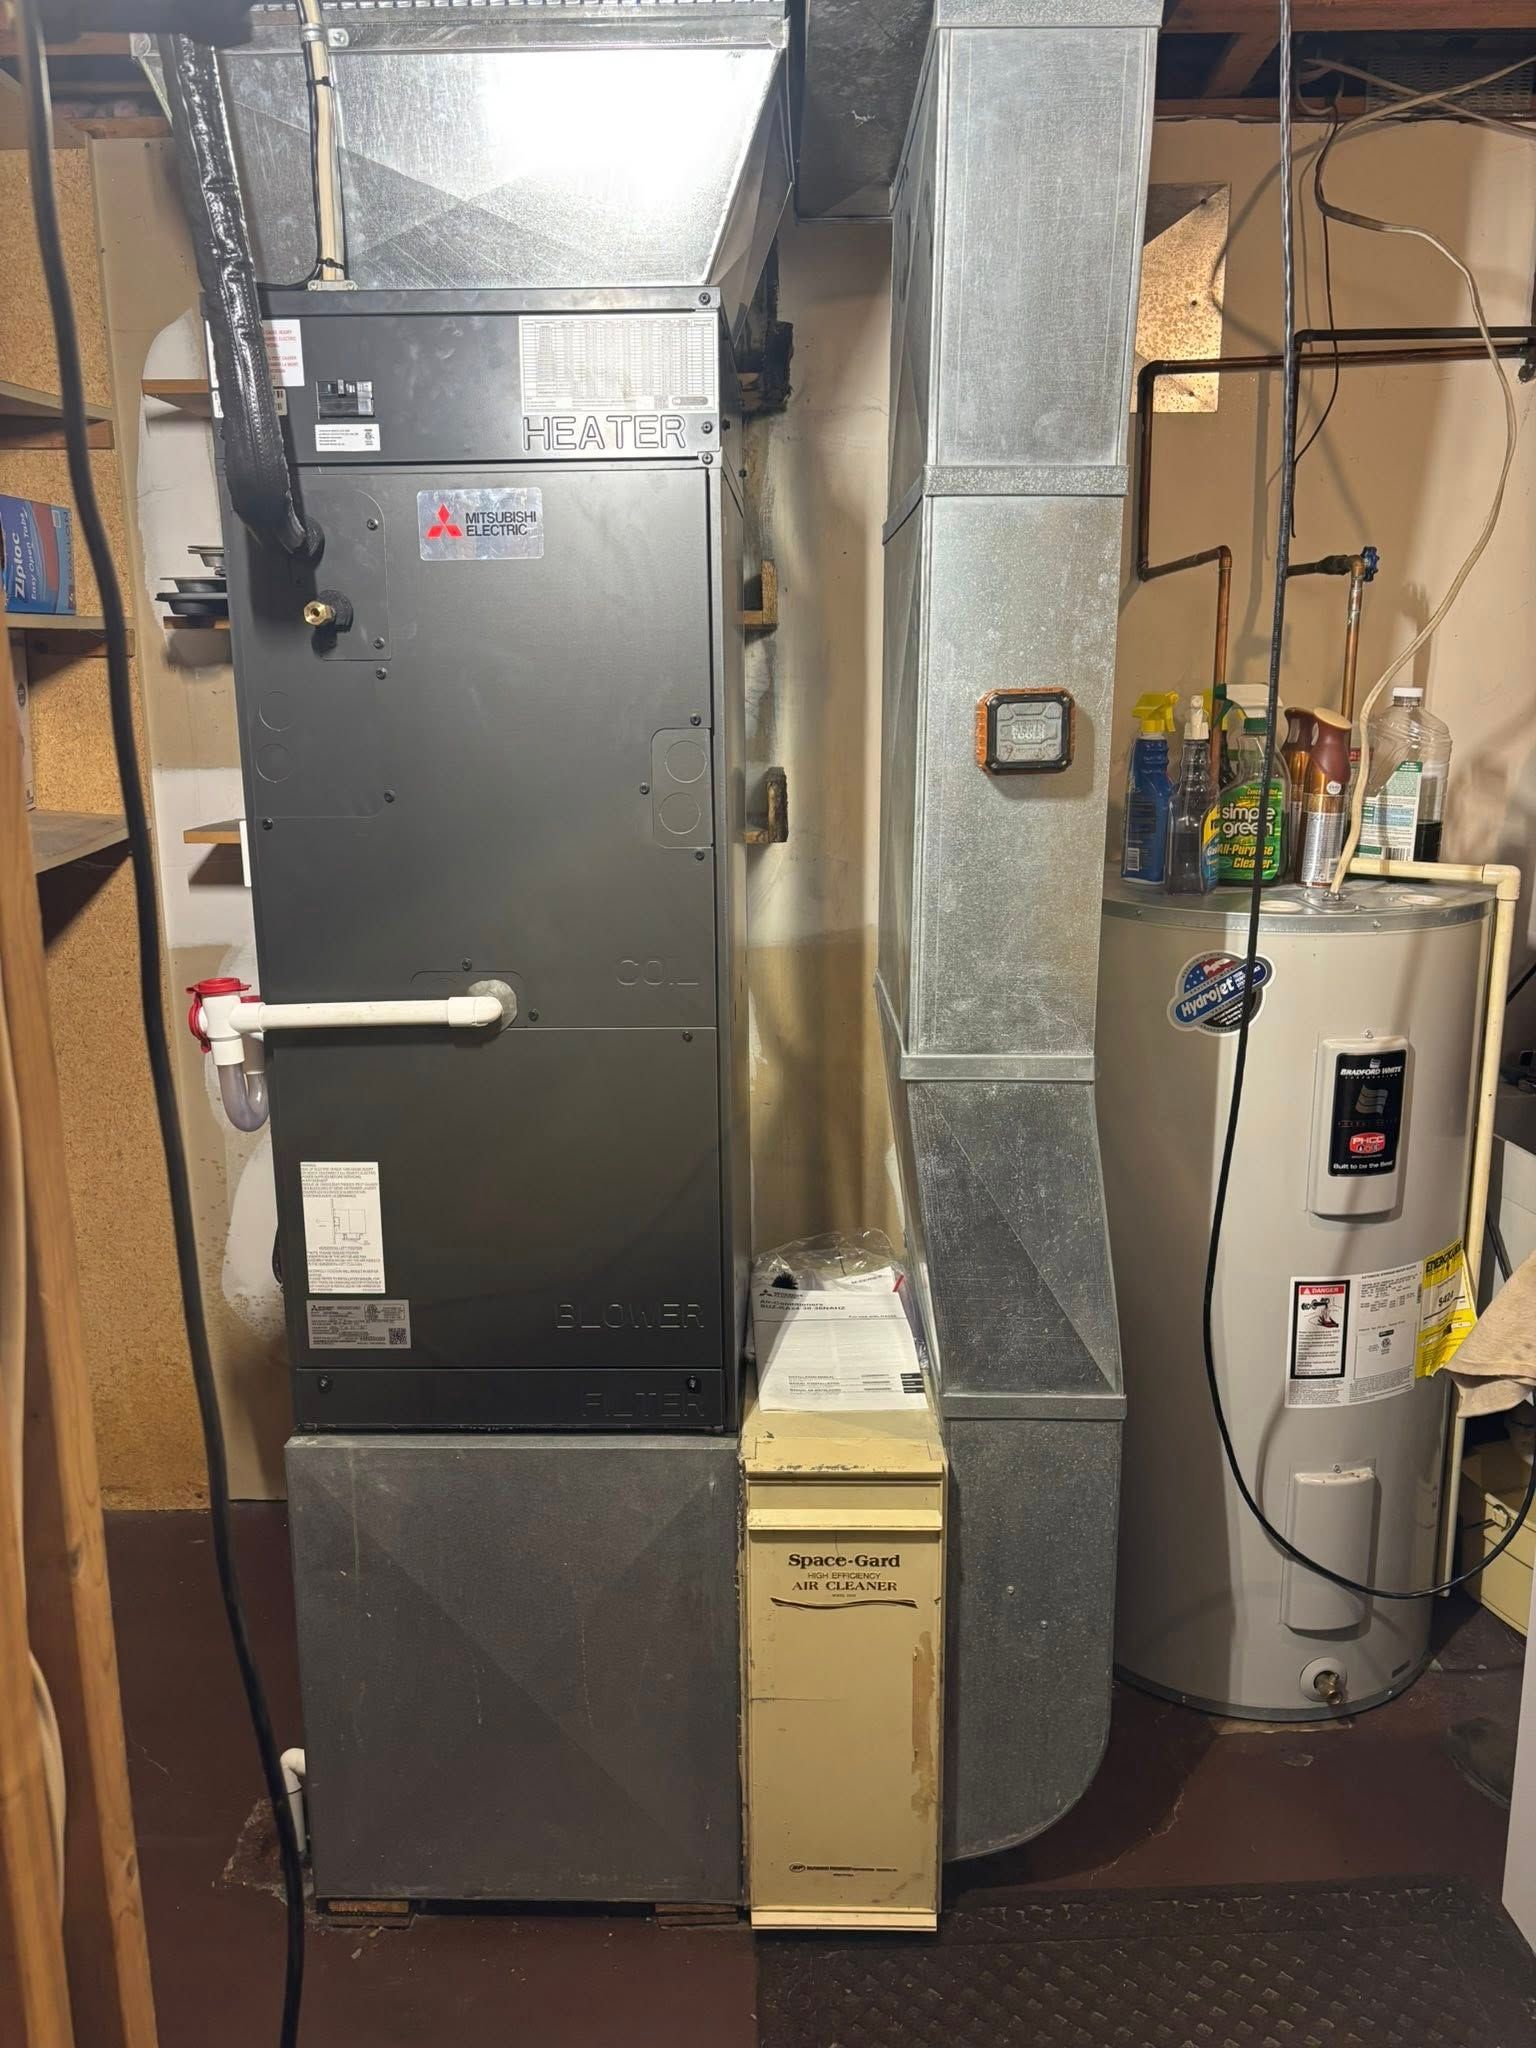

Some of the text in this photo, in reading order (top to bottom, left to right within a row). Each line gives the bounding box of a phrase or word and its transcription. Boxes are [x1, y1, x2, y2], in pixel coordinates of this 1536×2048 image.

[523, 414, 686, 450] HEATER
[465, 511, 537, 524] MITSUBISHI
[466, 523, 528, 537] ELECTRIC
[12, 532, 26, 599] Ziploc
[27, 542, 36, 573] Open
[1222, 802, 1276, 822] simpe
[1217, 843, 1274, 857] All-Purpse
[1233, 857, 1274, 869] Cleaer
[616, 959, 699, 986] COIL
[1180, 977, 1235, 1017] Hydrojet
[1340, 1068, 1381, 1076] BRADFORD
[555, 1303, 704, 1329] BLOWER
[582, 1392, 704, 1417] FILTER
[788, 1553, 900, 1569] Space-Gard
[807, 1572, 881, 1580] HIGH EFFICIENCY
[792, 1581, 898, 1592] AIR CLEANER
